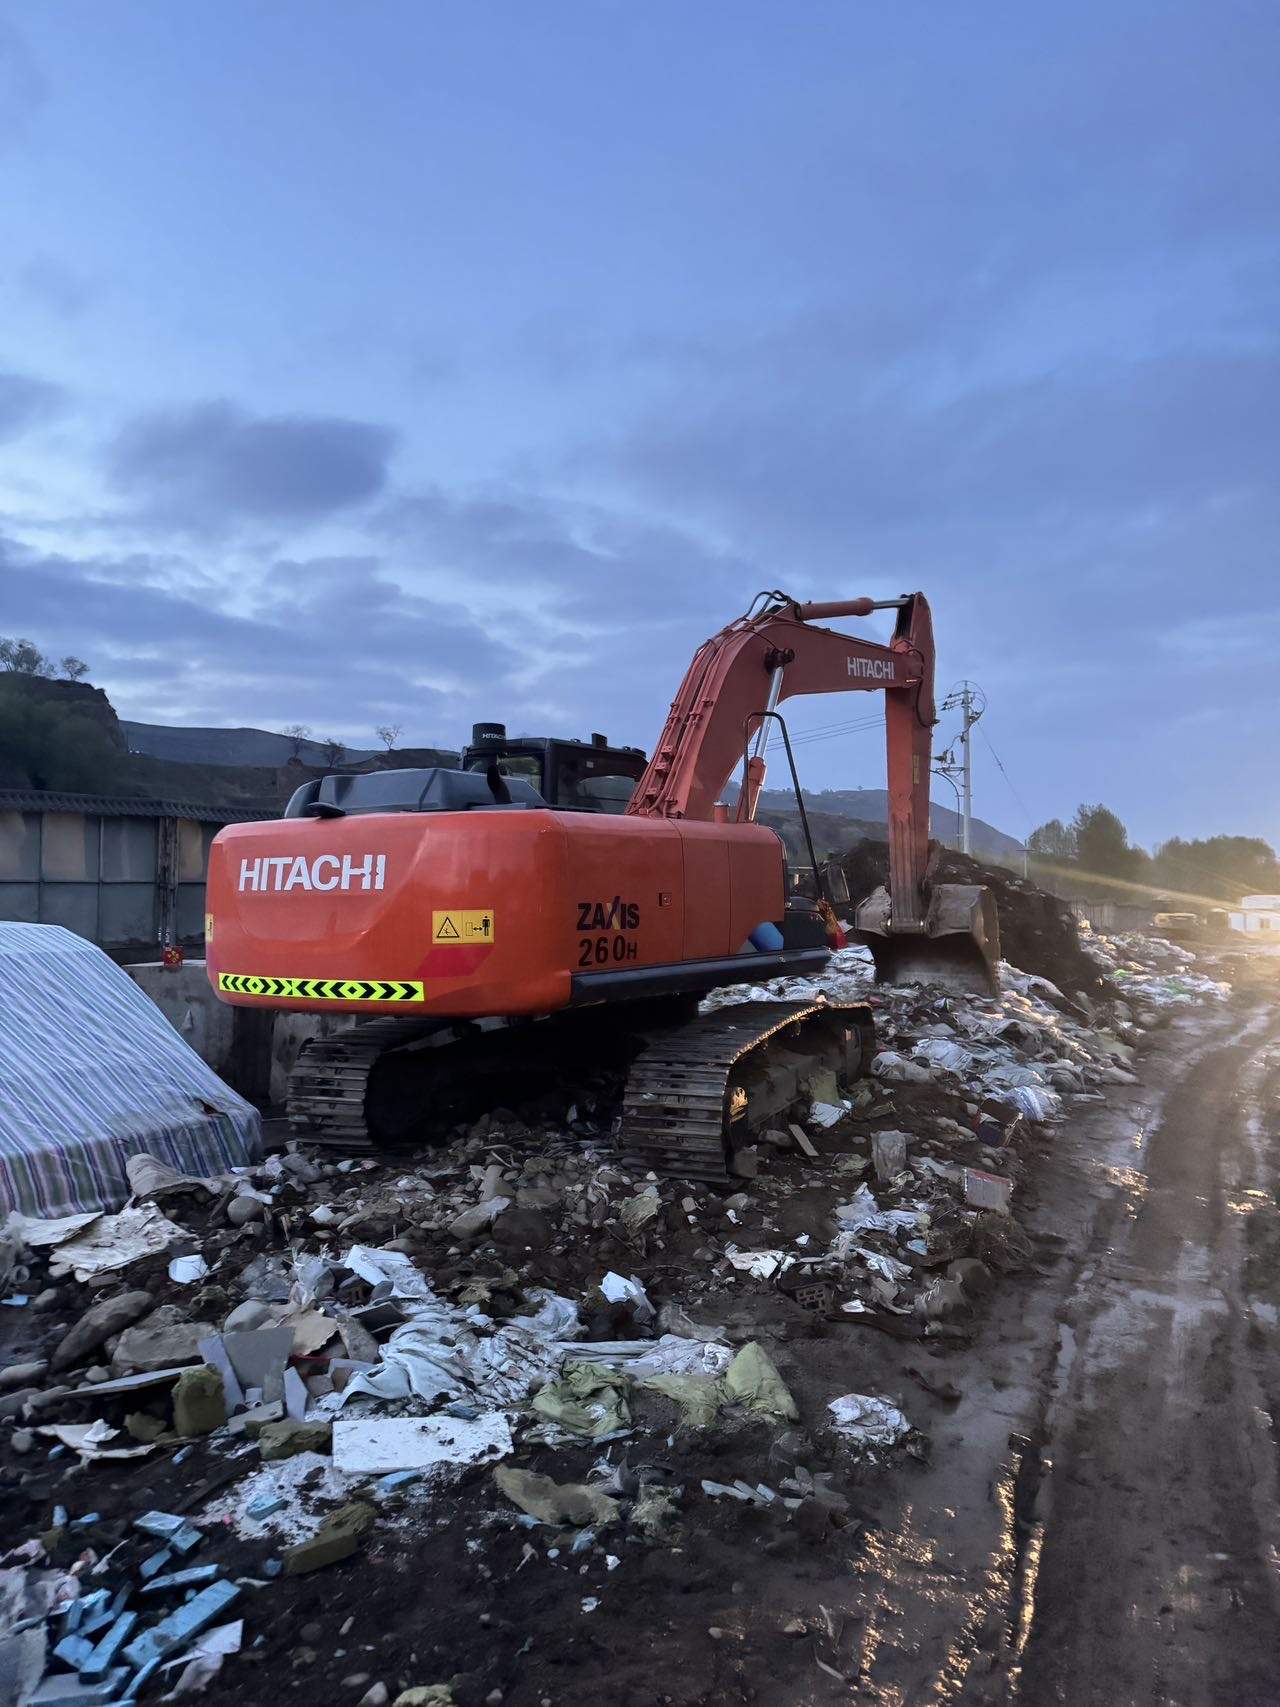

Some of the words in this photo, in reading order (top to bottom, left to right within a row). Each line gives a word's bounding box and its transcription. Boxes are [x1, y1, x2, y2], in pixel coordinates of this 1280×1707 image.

[847, 656, 895, 680] HITACHI
[238, 854, 386, 891] HITACHI
[576, 895, 640, 931] ZAXIS
